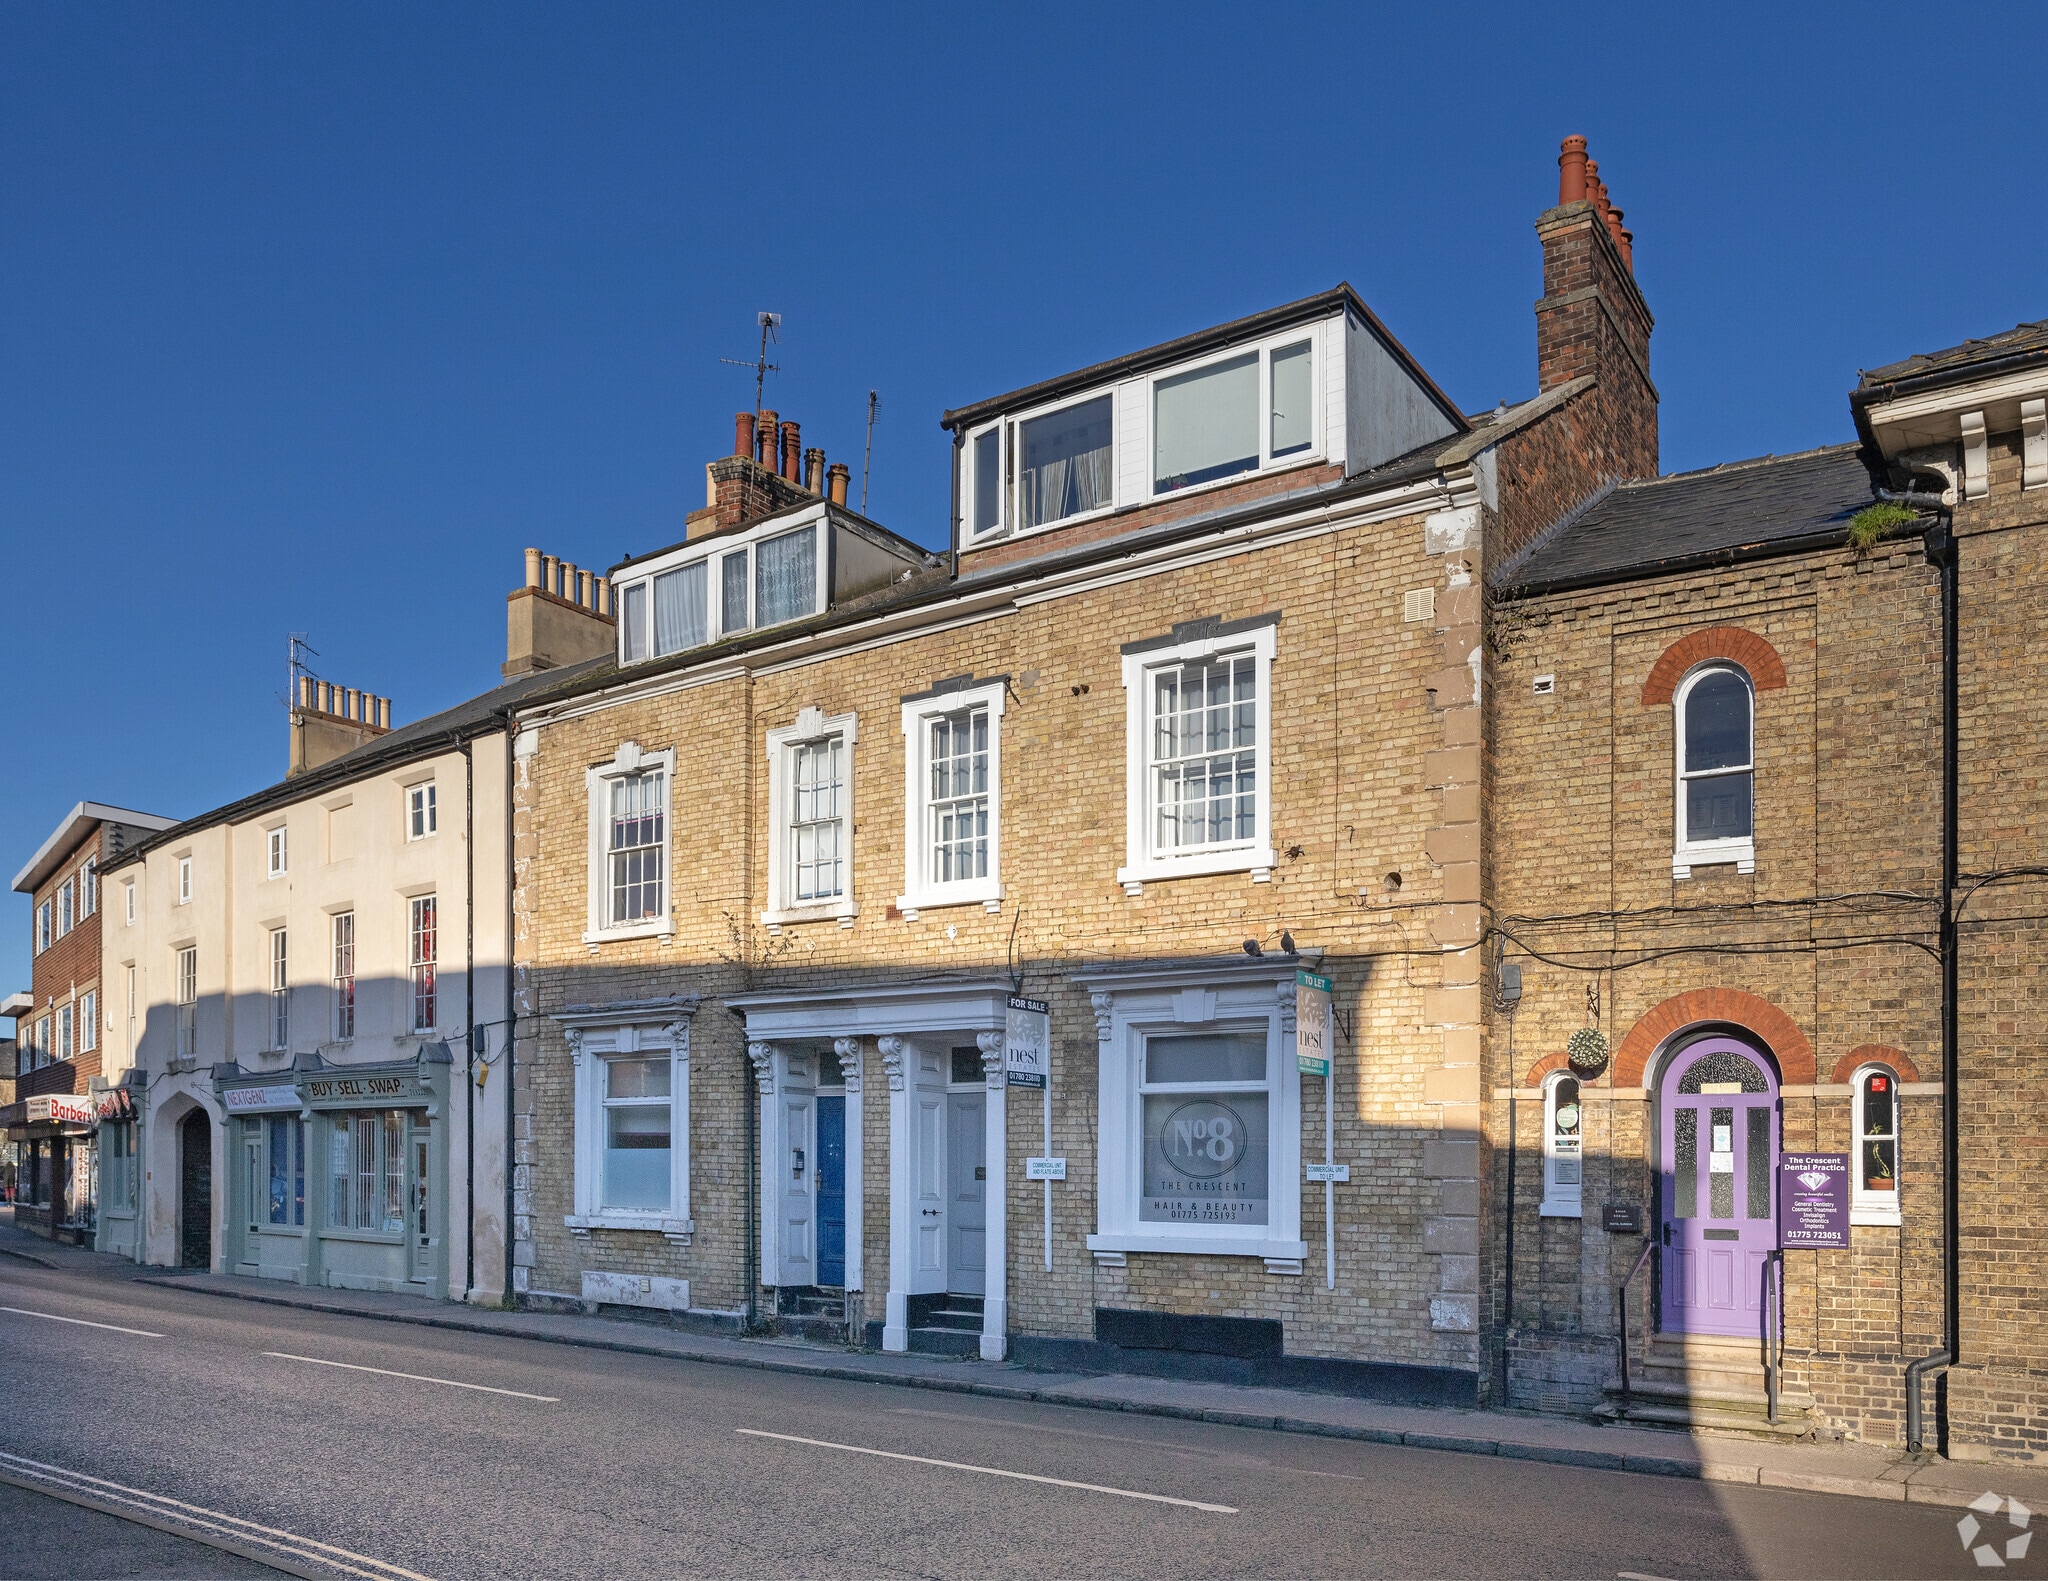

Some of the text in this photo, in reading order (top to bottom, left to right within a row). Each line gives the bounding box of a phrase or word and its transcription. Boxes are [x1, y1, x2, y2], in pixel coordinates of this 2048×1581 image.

[1304, 975, 1325, 989] TO LET
[1010, 999, 1045, 1012] FOR SALE
[1299, 1030, 1323, 1050] nest
[1009, 1047, 1039, 1065] nest
[1298, 1046, 1324, 1058] ESTATES
[1008, 1062, 1040, 1073] ESTATES
[311, 1082, 333, 1096] BUY
[337, 1080, 363, 1095] SELL
[368, 1078, 401, 1094] SWAP
[51, 1098, 92, 1123] Barbers
[1161, 1181, 1246, 1191] THE CRESCENT
[1154, 1202, 1253, 1212] HAIR & BEAUTY
[1171, 1211, 1236, 1220] 01775 725193
[1787, 1230, 1841, 1240] 01775 723051
